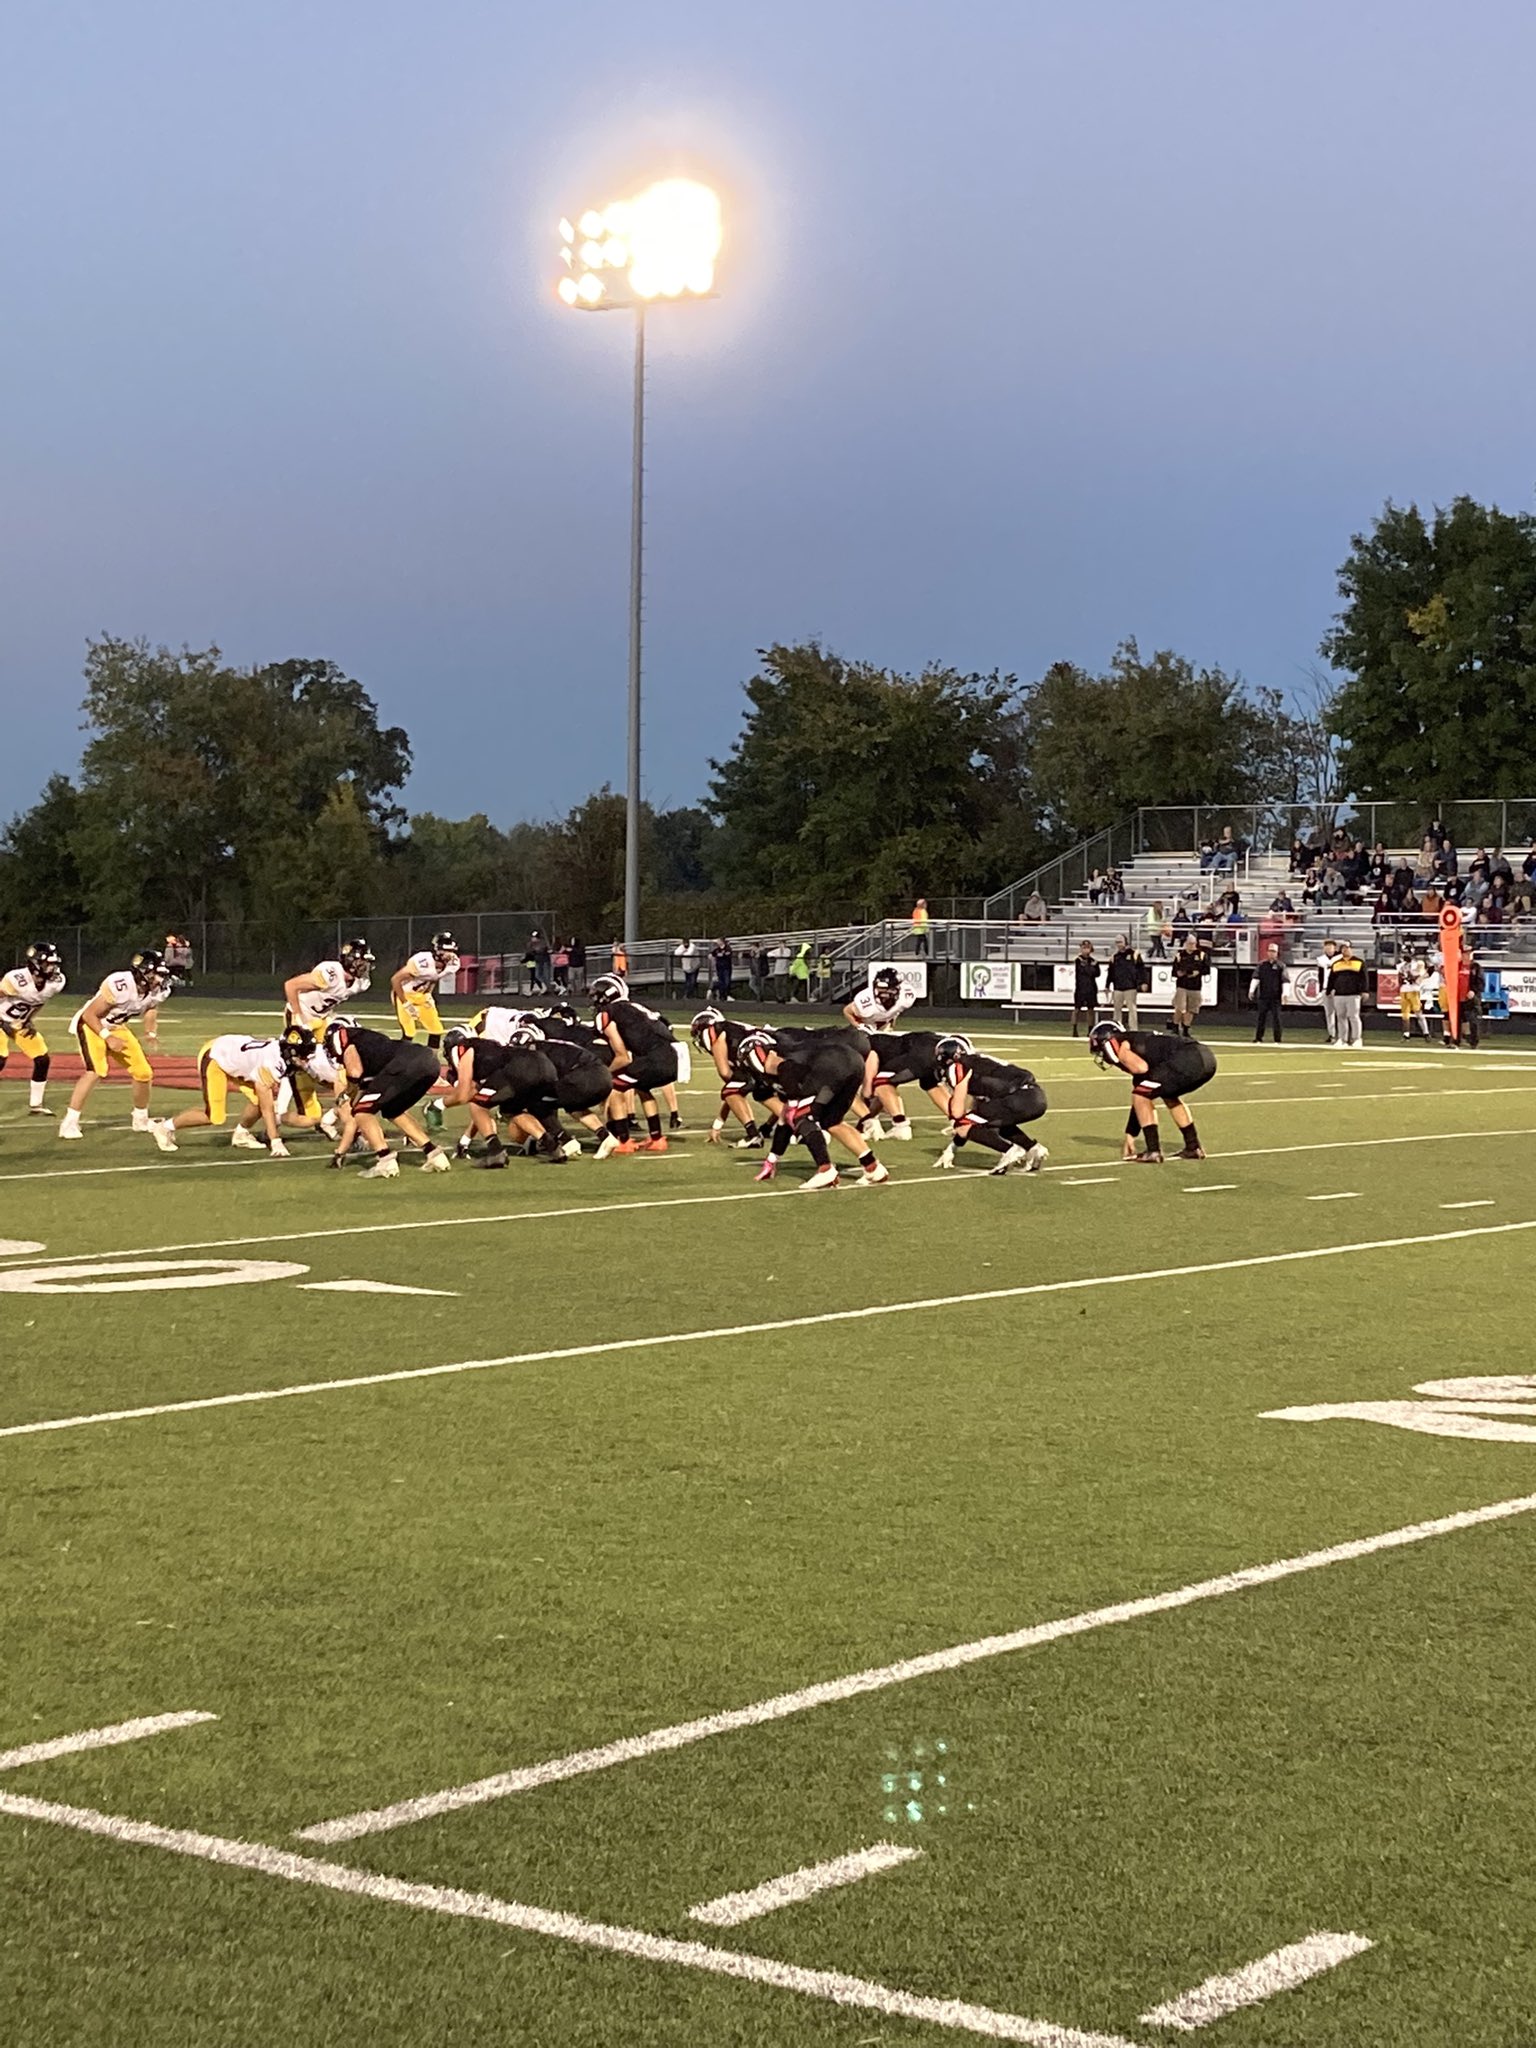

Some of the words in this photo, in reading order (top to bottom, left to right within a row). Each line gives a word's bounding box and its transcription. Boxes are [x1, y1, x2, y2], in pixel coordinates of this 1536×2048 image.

[13, 973, 28, 988] 20
[113, 978, 128, 993] 15
[860, 997, 873, 1009] 31
